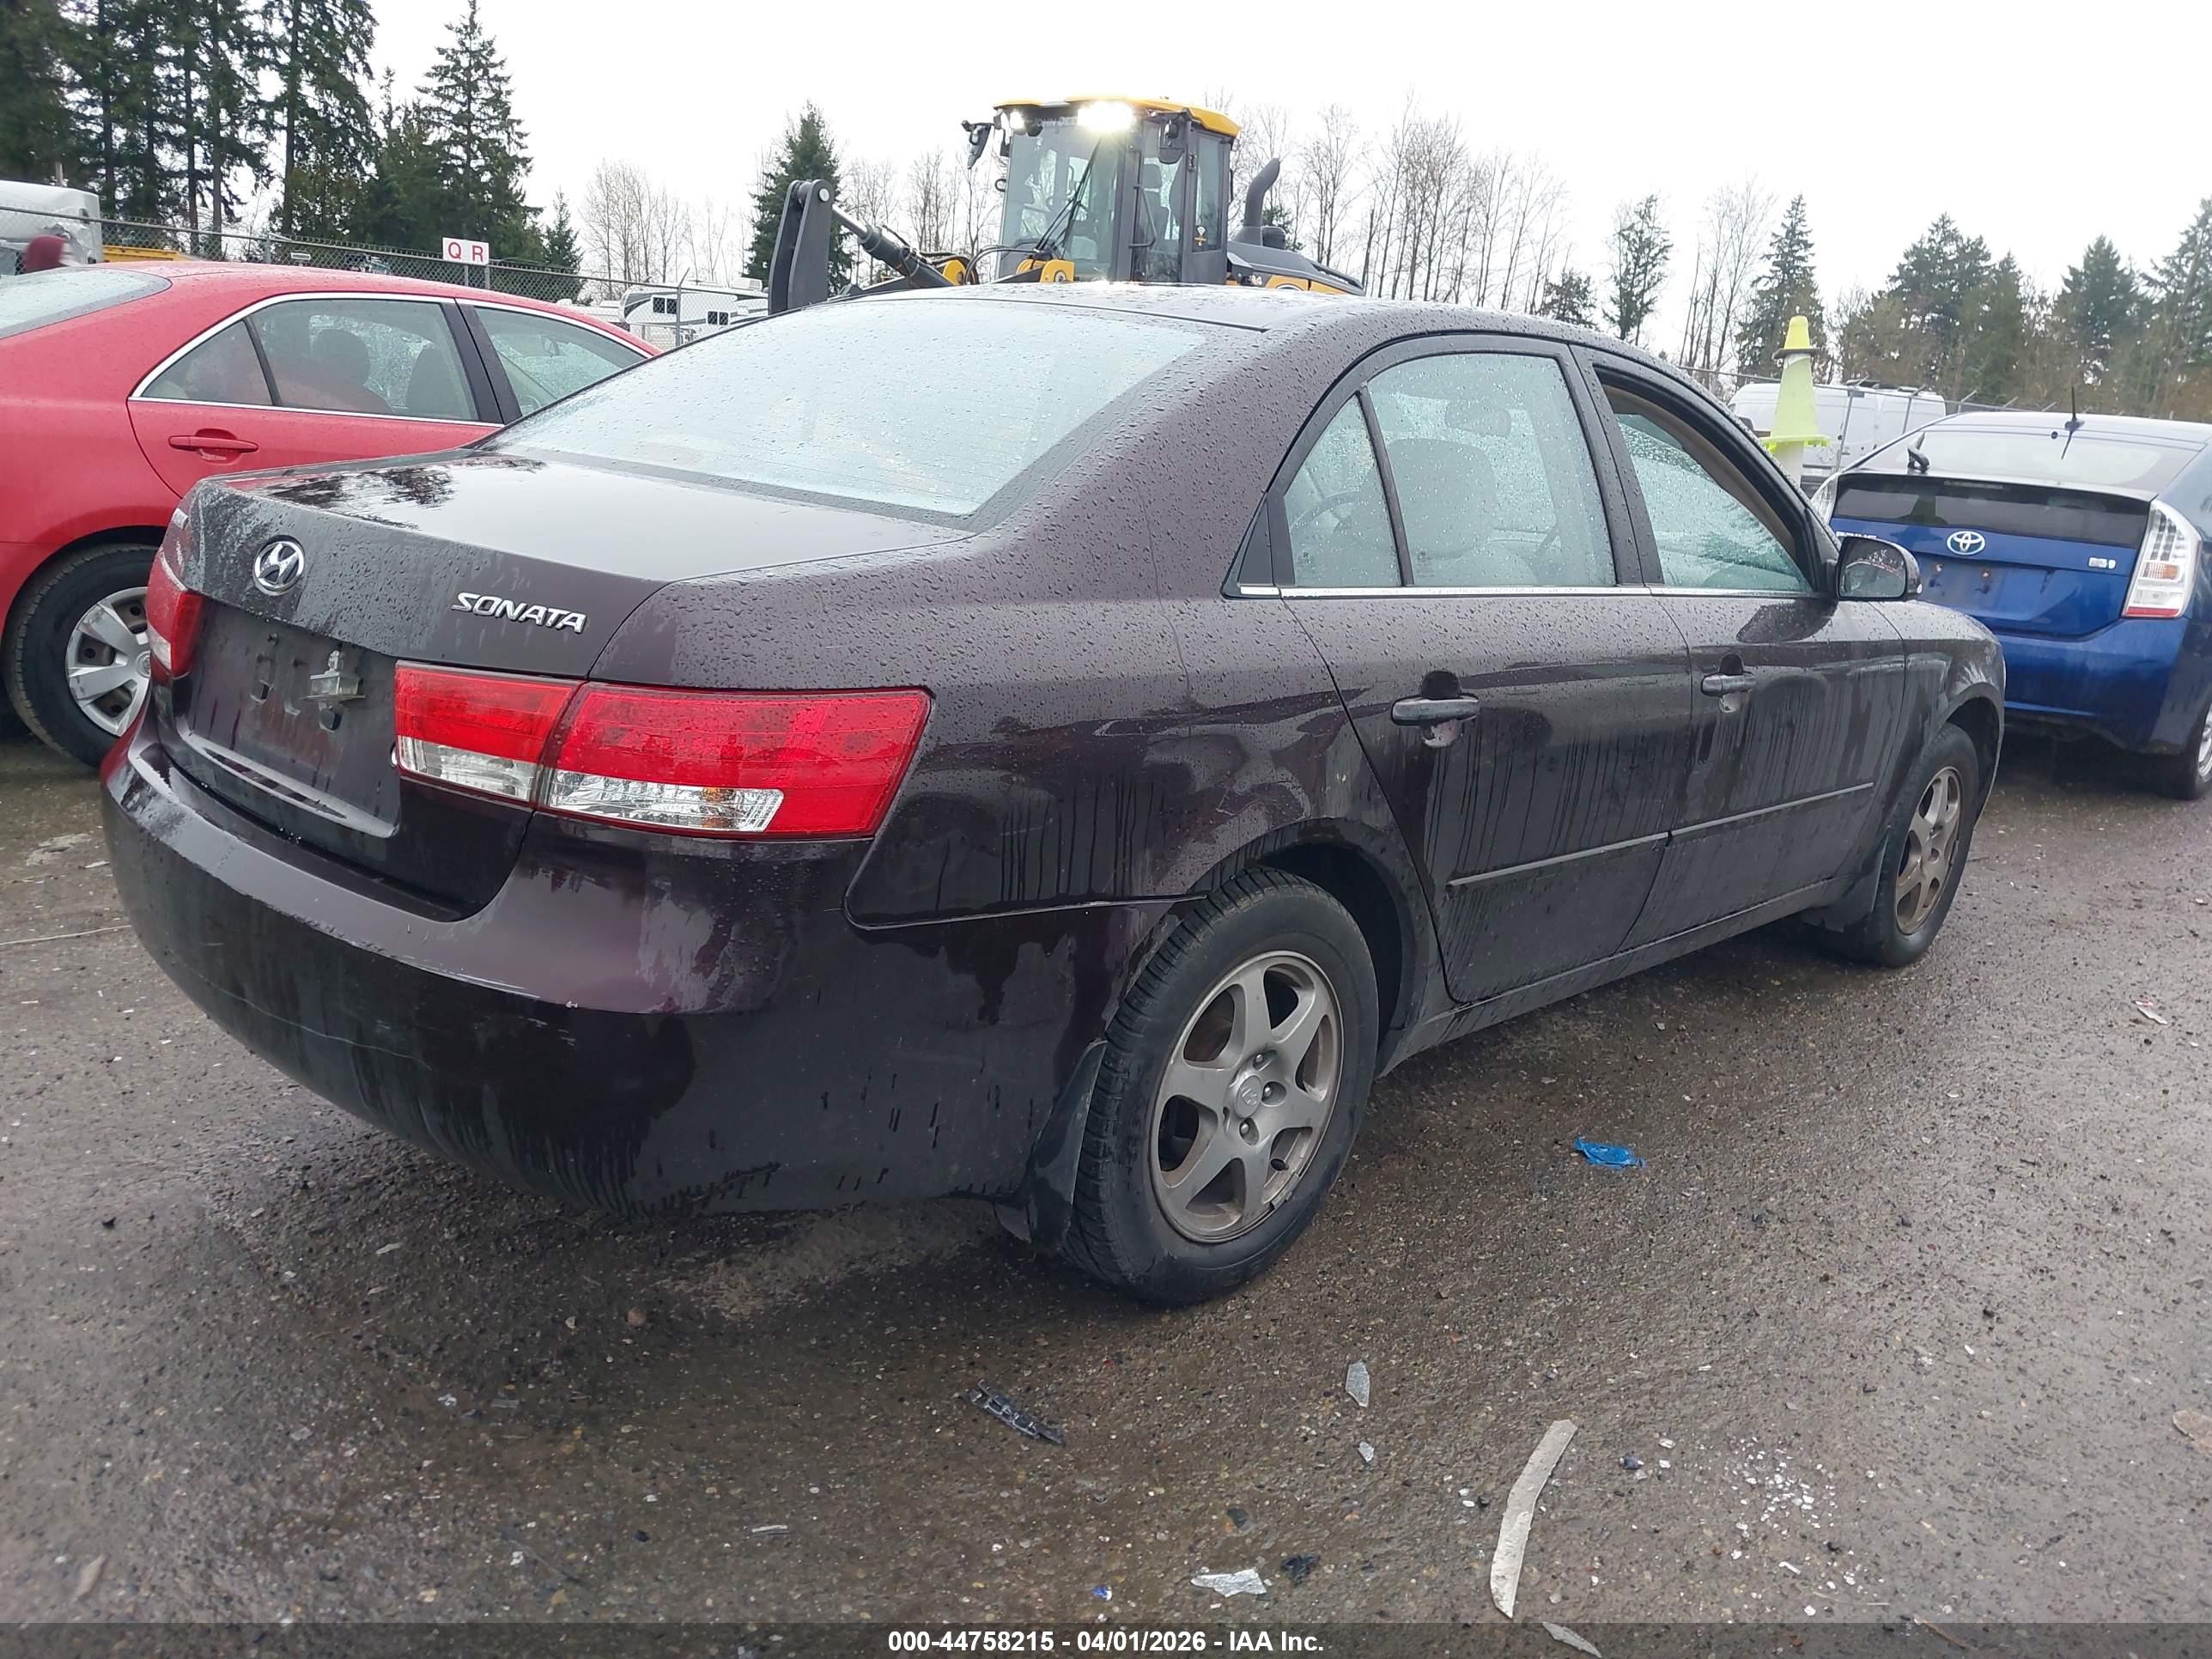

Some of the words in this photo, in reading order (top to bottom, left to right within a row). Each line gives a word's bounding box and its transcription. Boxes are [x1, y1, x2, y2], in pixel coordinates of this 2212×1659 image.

[447, 241, 462, 259] Q
[471, 244, 484, 262] R
[451, 592, 587, 635] SONATA
